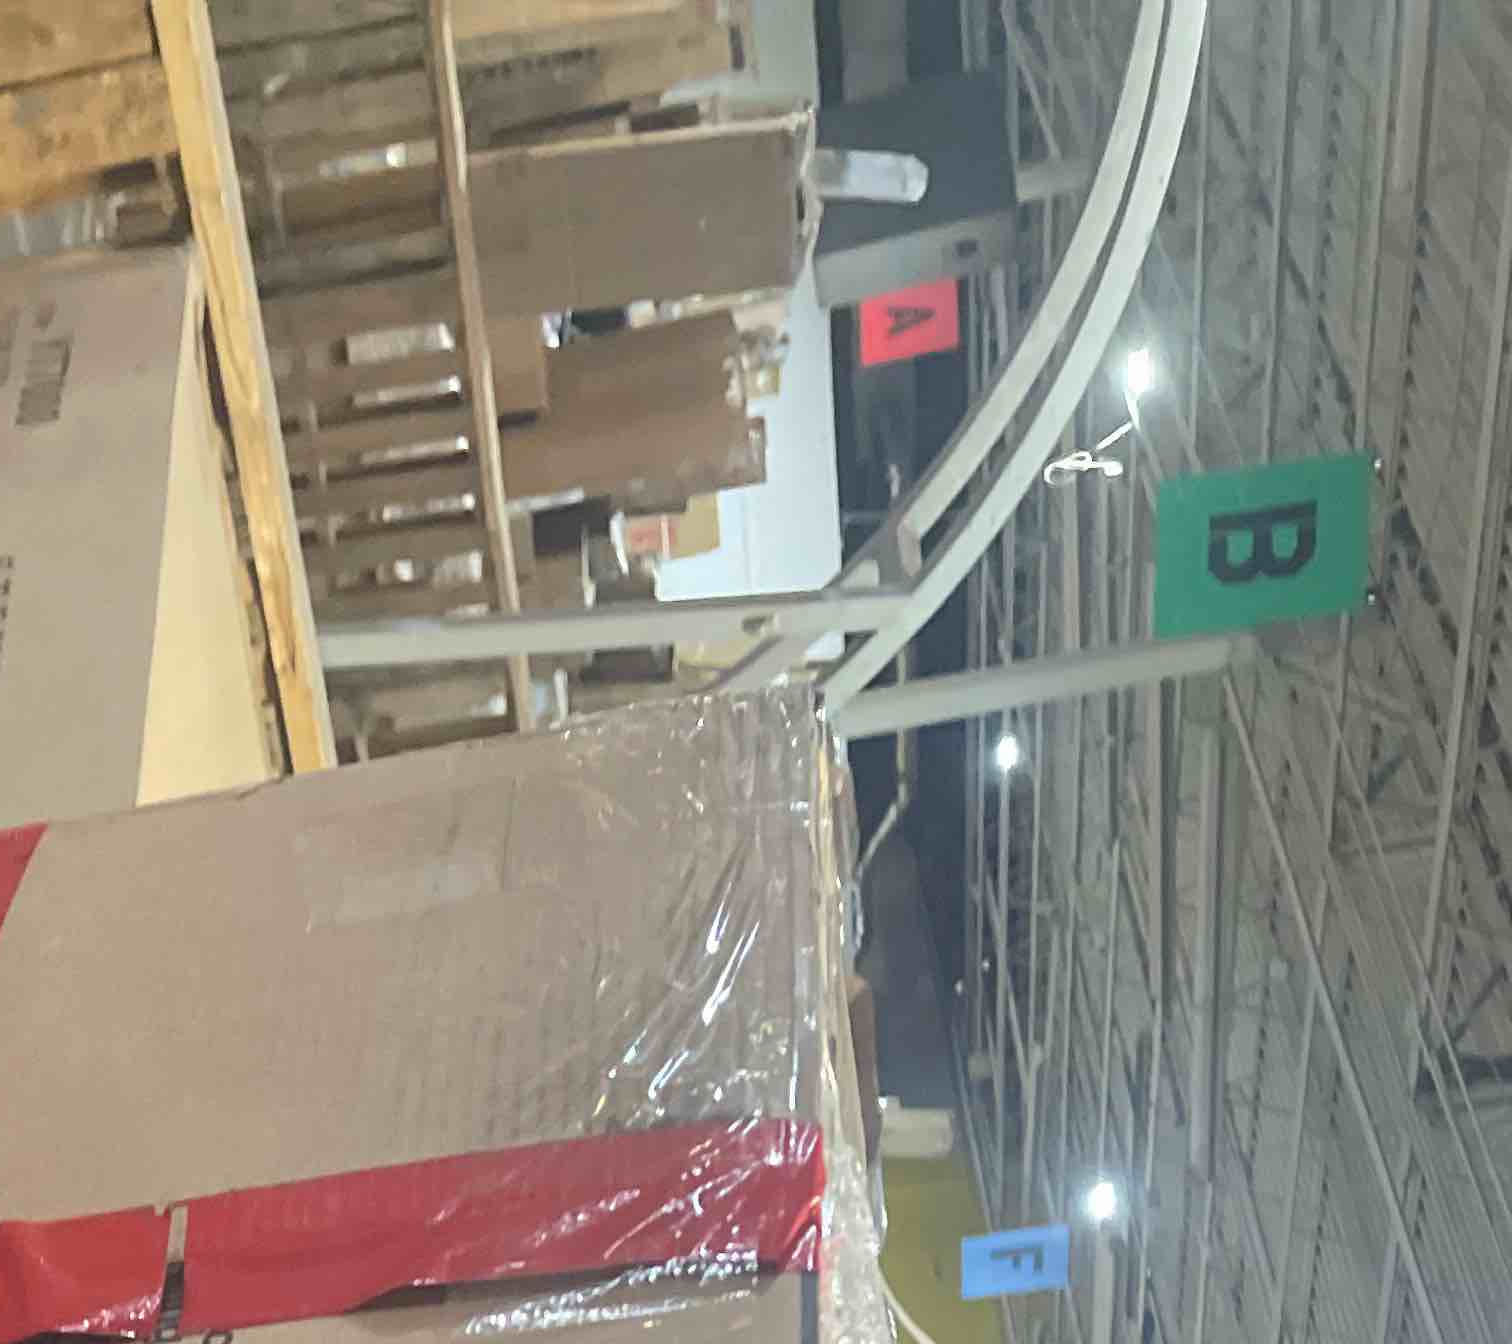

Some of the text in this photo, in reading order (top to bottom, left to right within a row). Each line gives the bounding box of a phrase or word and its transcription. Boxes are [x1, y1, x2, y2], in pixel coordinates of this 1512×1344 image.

[881, 305, 936, 337] A
[1206, 500, 1317, 588] B
[989, 1241, 1045, 1284] F
